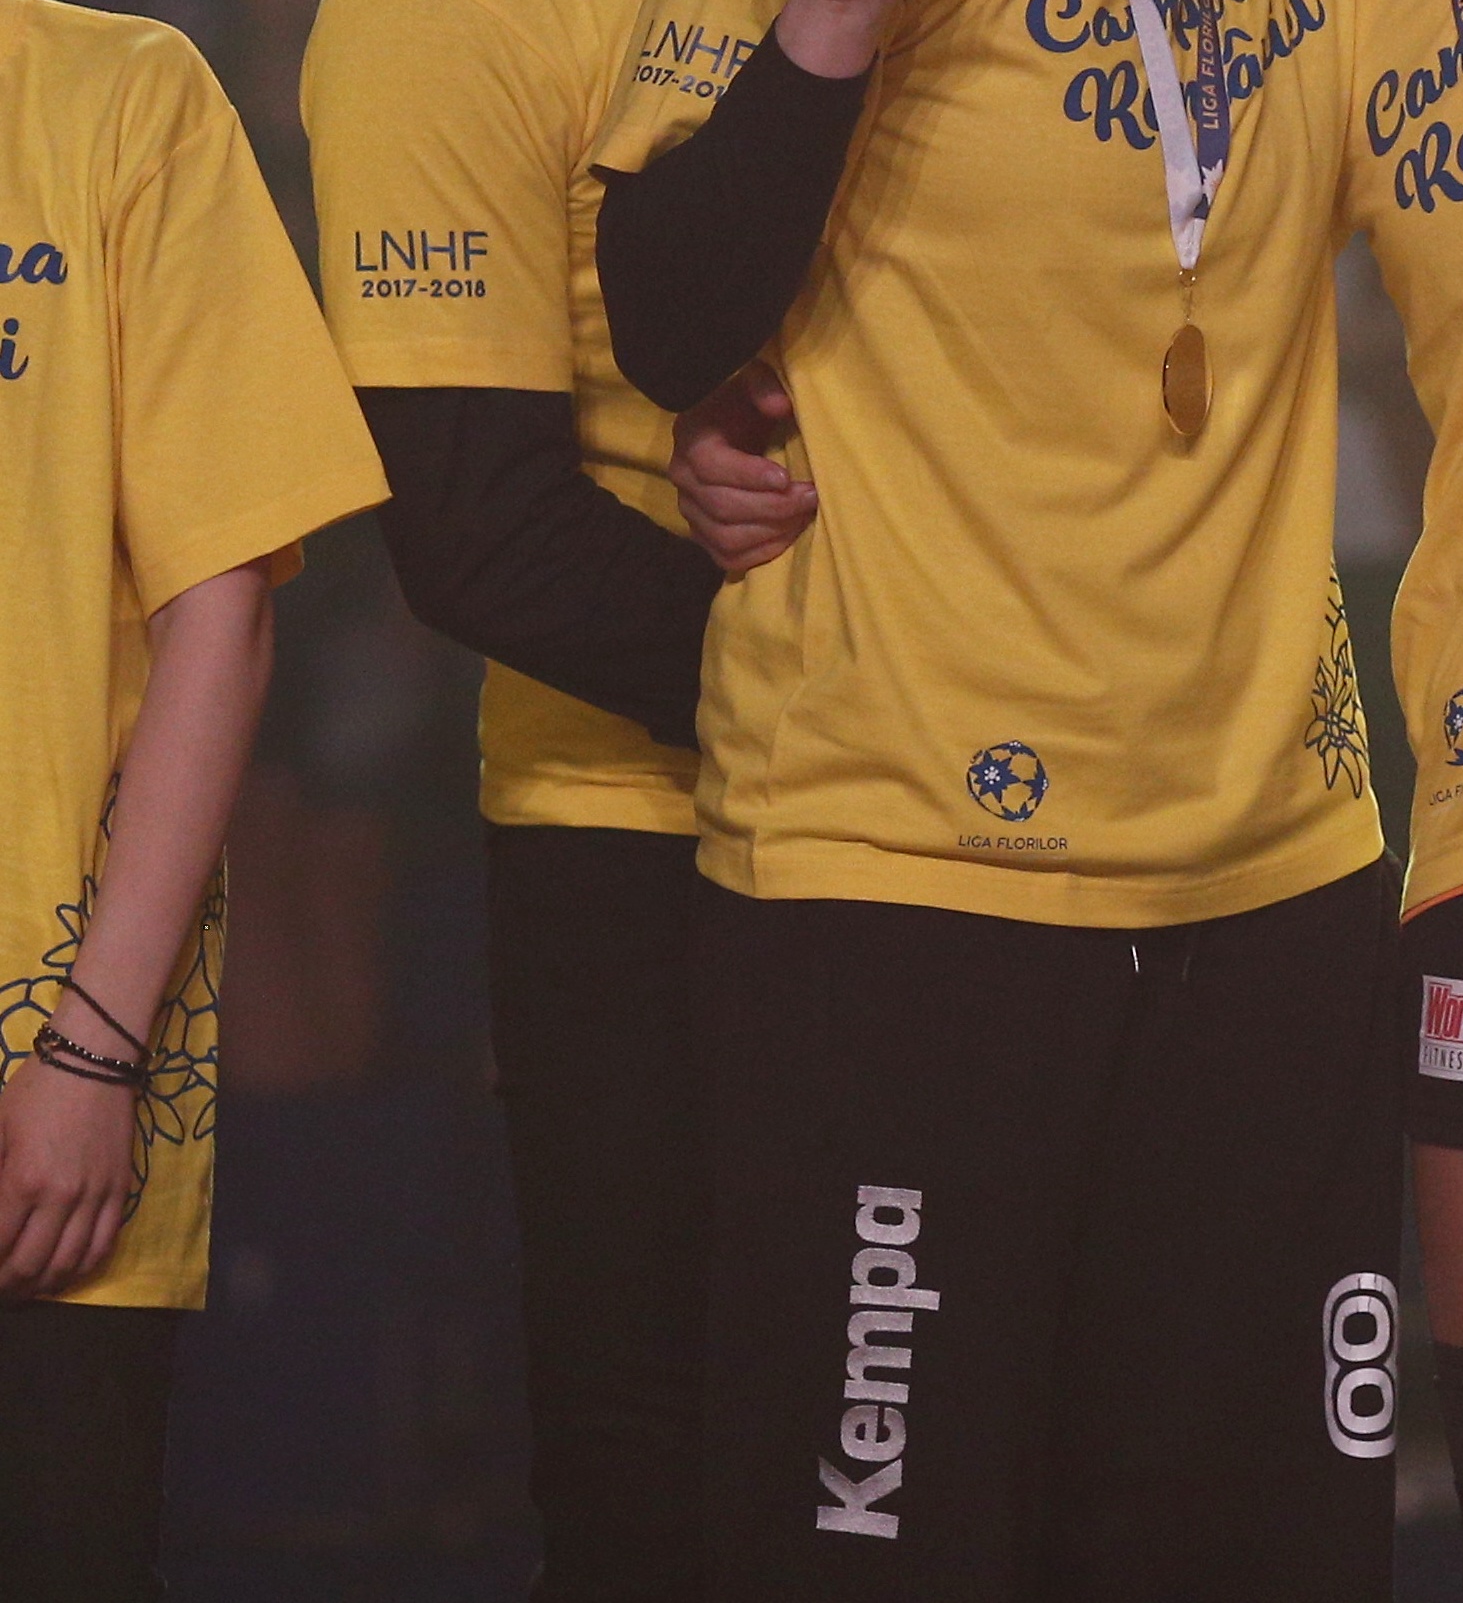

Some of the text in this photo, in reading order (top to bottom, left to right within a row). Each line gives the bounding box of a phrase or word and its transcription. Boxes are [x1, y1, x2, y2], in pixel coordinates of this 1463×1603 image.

[1202, 84, 1220, 130] LIGA
[355, 230, 489, 272] LNHF
[361, 278, 487, 298] 2017-2018
[958, 835, 1068, 850] LIGA FLORILOR
[815, 1184, 941, 1540] Kempa
